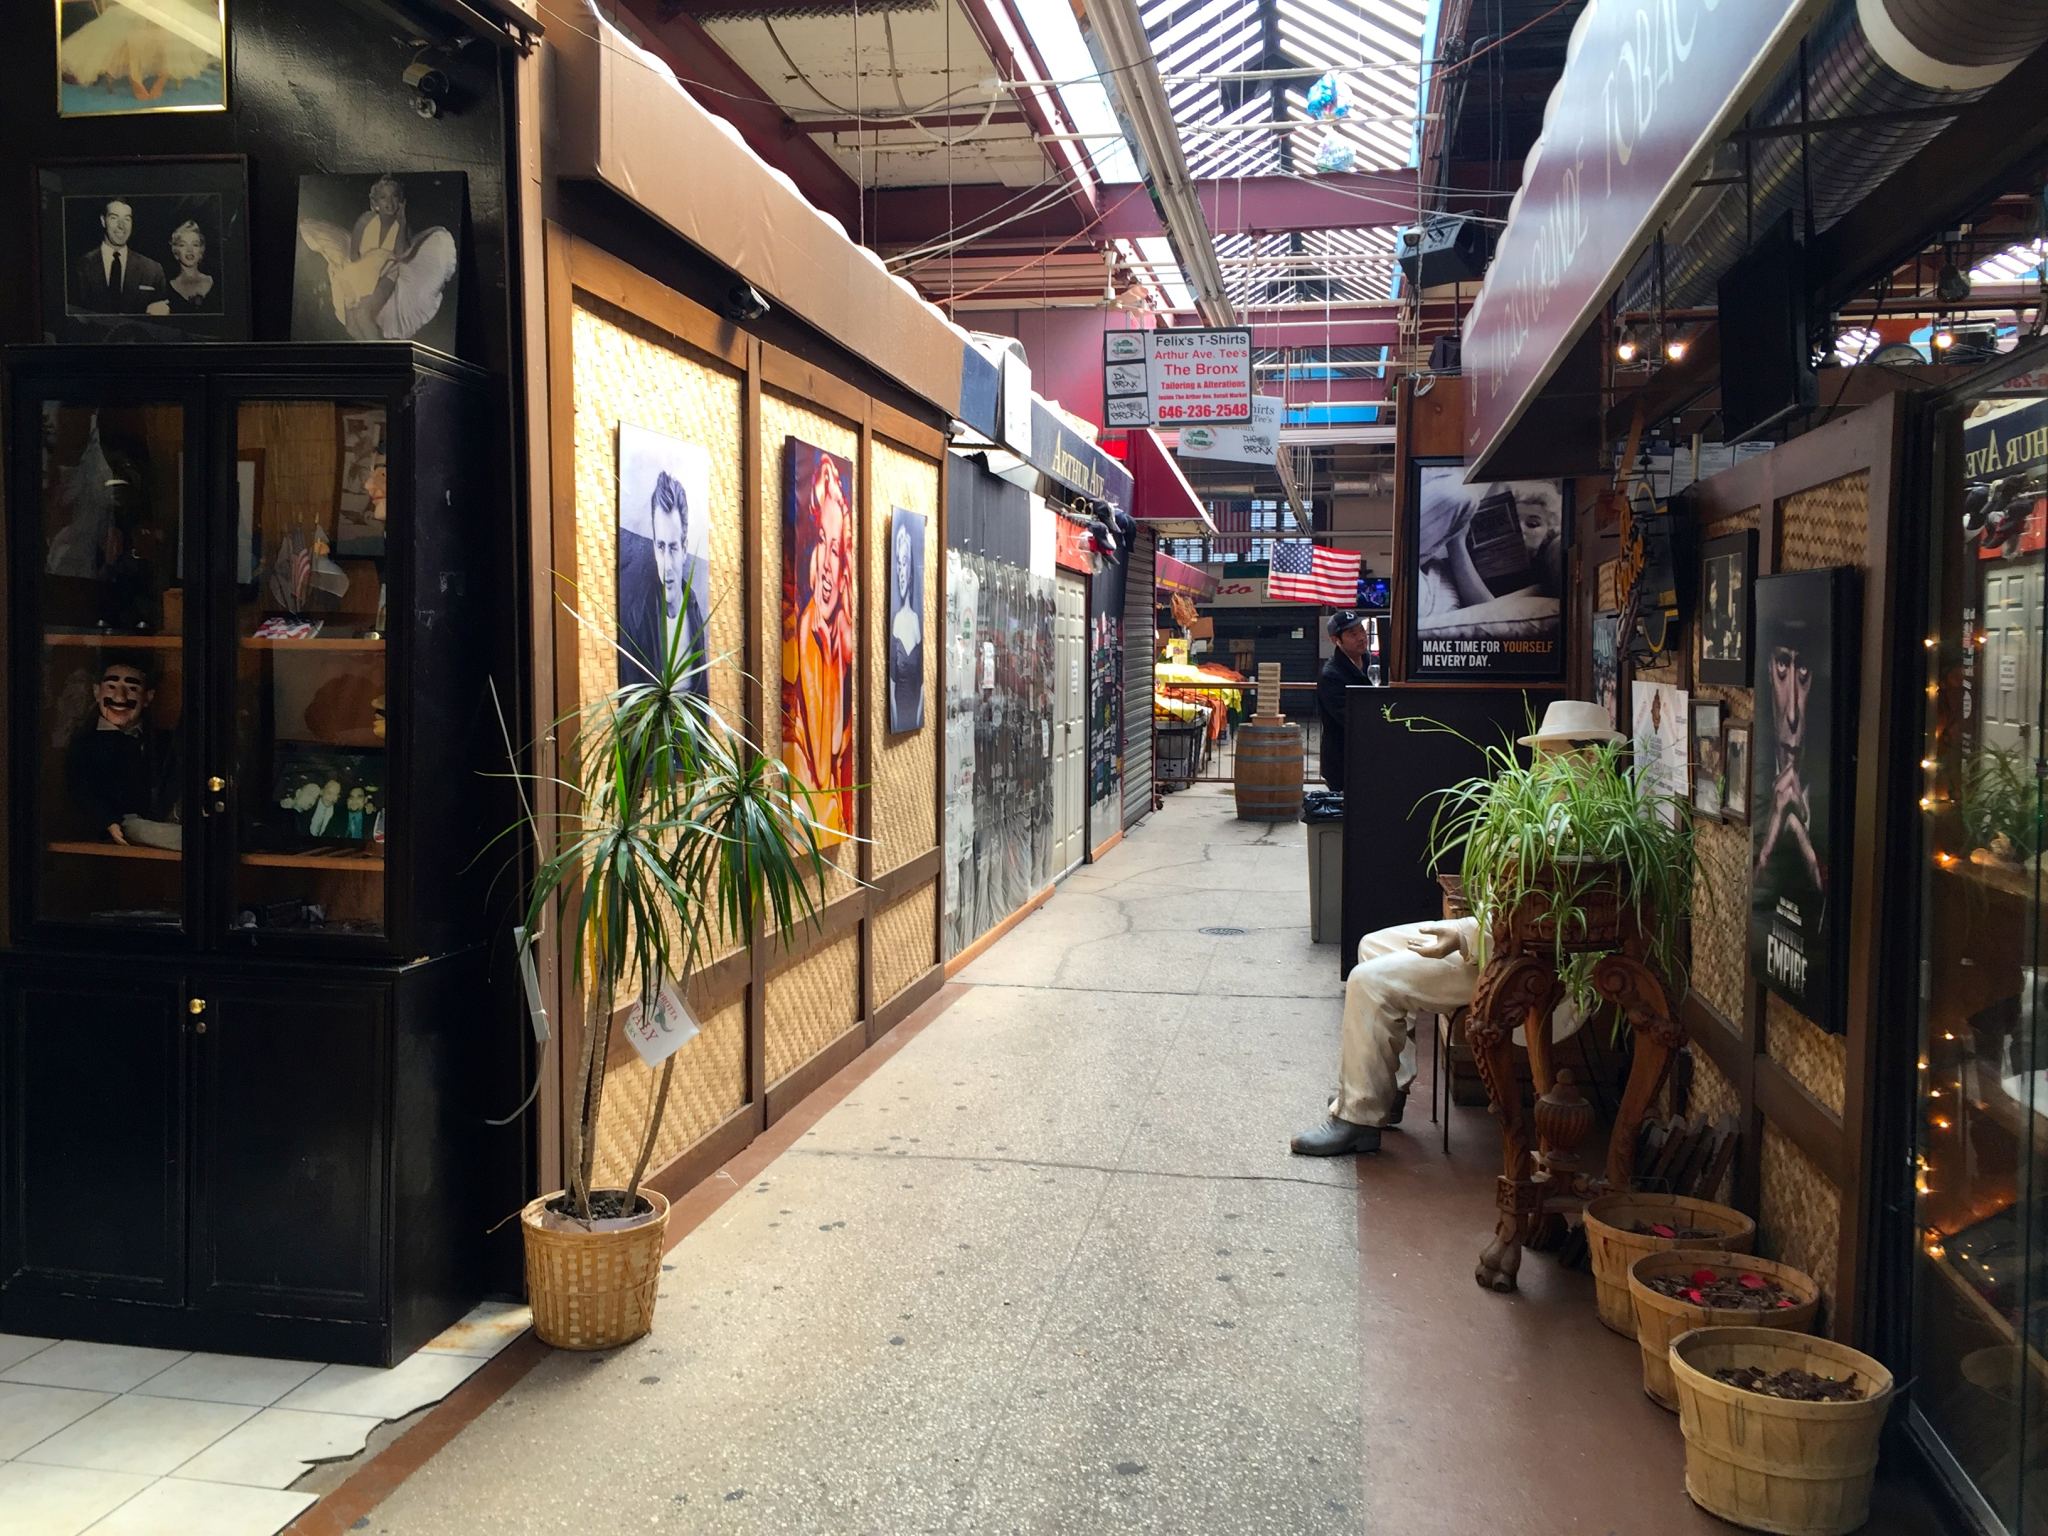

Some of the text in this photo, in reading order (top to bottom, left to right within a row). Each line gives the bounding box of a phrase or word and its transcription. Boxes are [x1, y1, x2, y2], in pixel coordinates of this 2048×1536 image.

[1531, 136, 1589, 323] GRANDE
[1156, 334, 1246, 347] Felix's T-Shirts
[1155, 348, 1247, 360] Arthur Ave. Tee's
[1164, 363, 1238, 375] The Bronx
[1161, 381, 1195, 390] Tailoring
[1204, 380, 1246, 389] Alterations
[1158, 403, 1248, 419] 646-236-2548
[1422, 641, 1553, 652] MAKE TIME FOR YOURSELF
[1422, 655, 1491, 667] IN EVERY DAY.
[1768, 934, 1808, 993] EMPIRE
